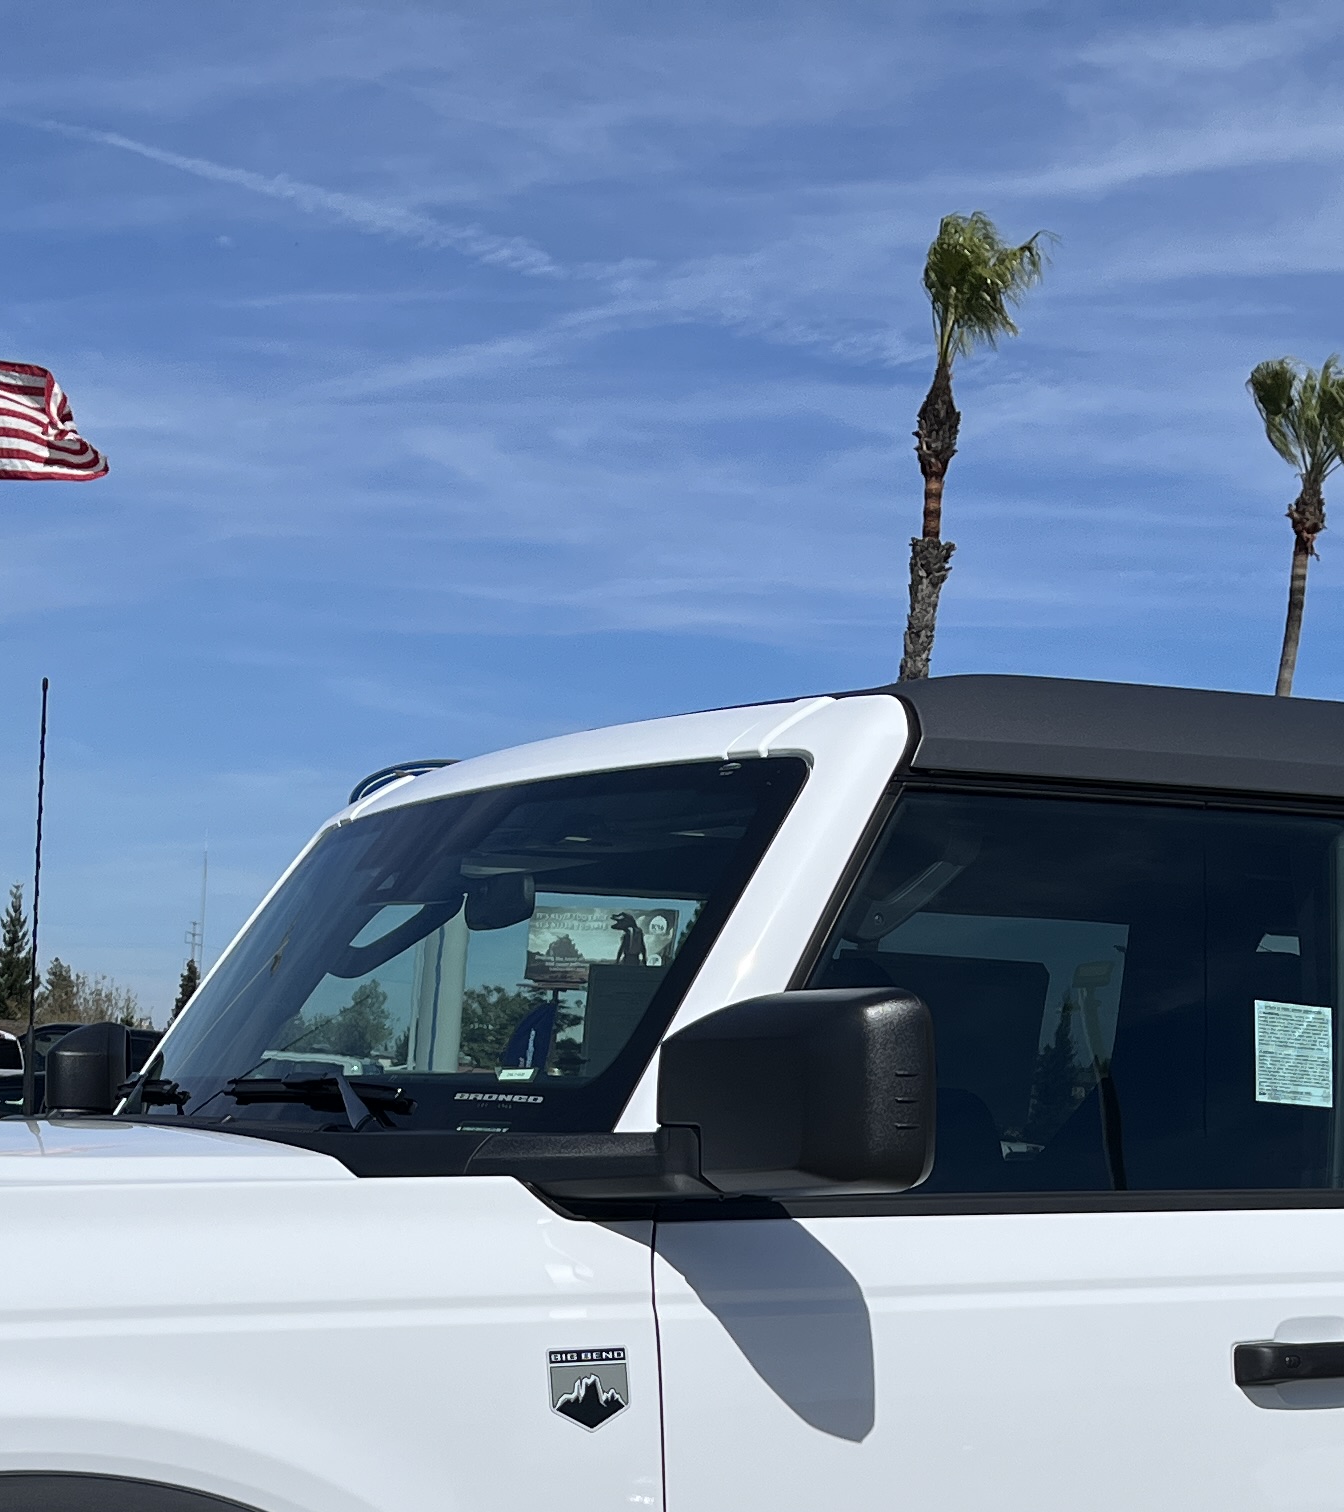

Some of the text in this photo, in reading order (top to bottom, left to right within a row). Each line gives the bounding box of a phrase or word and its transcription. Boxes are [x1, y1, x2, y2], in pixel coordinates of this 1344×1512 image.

[454, 1092, 544, 1103] BRONCO
[550, 1350, 624, 1362] BIG BEND
